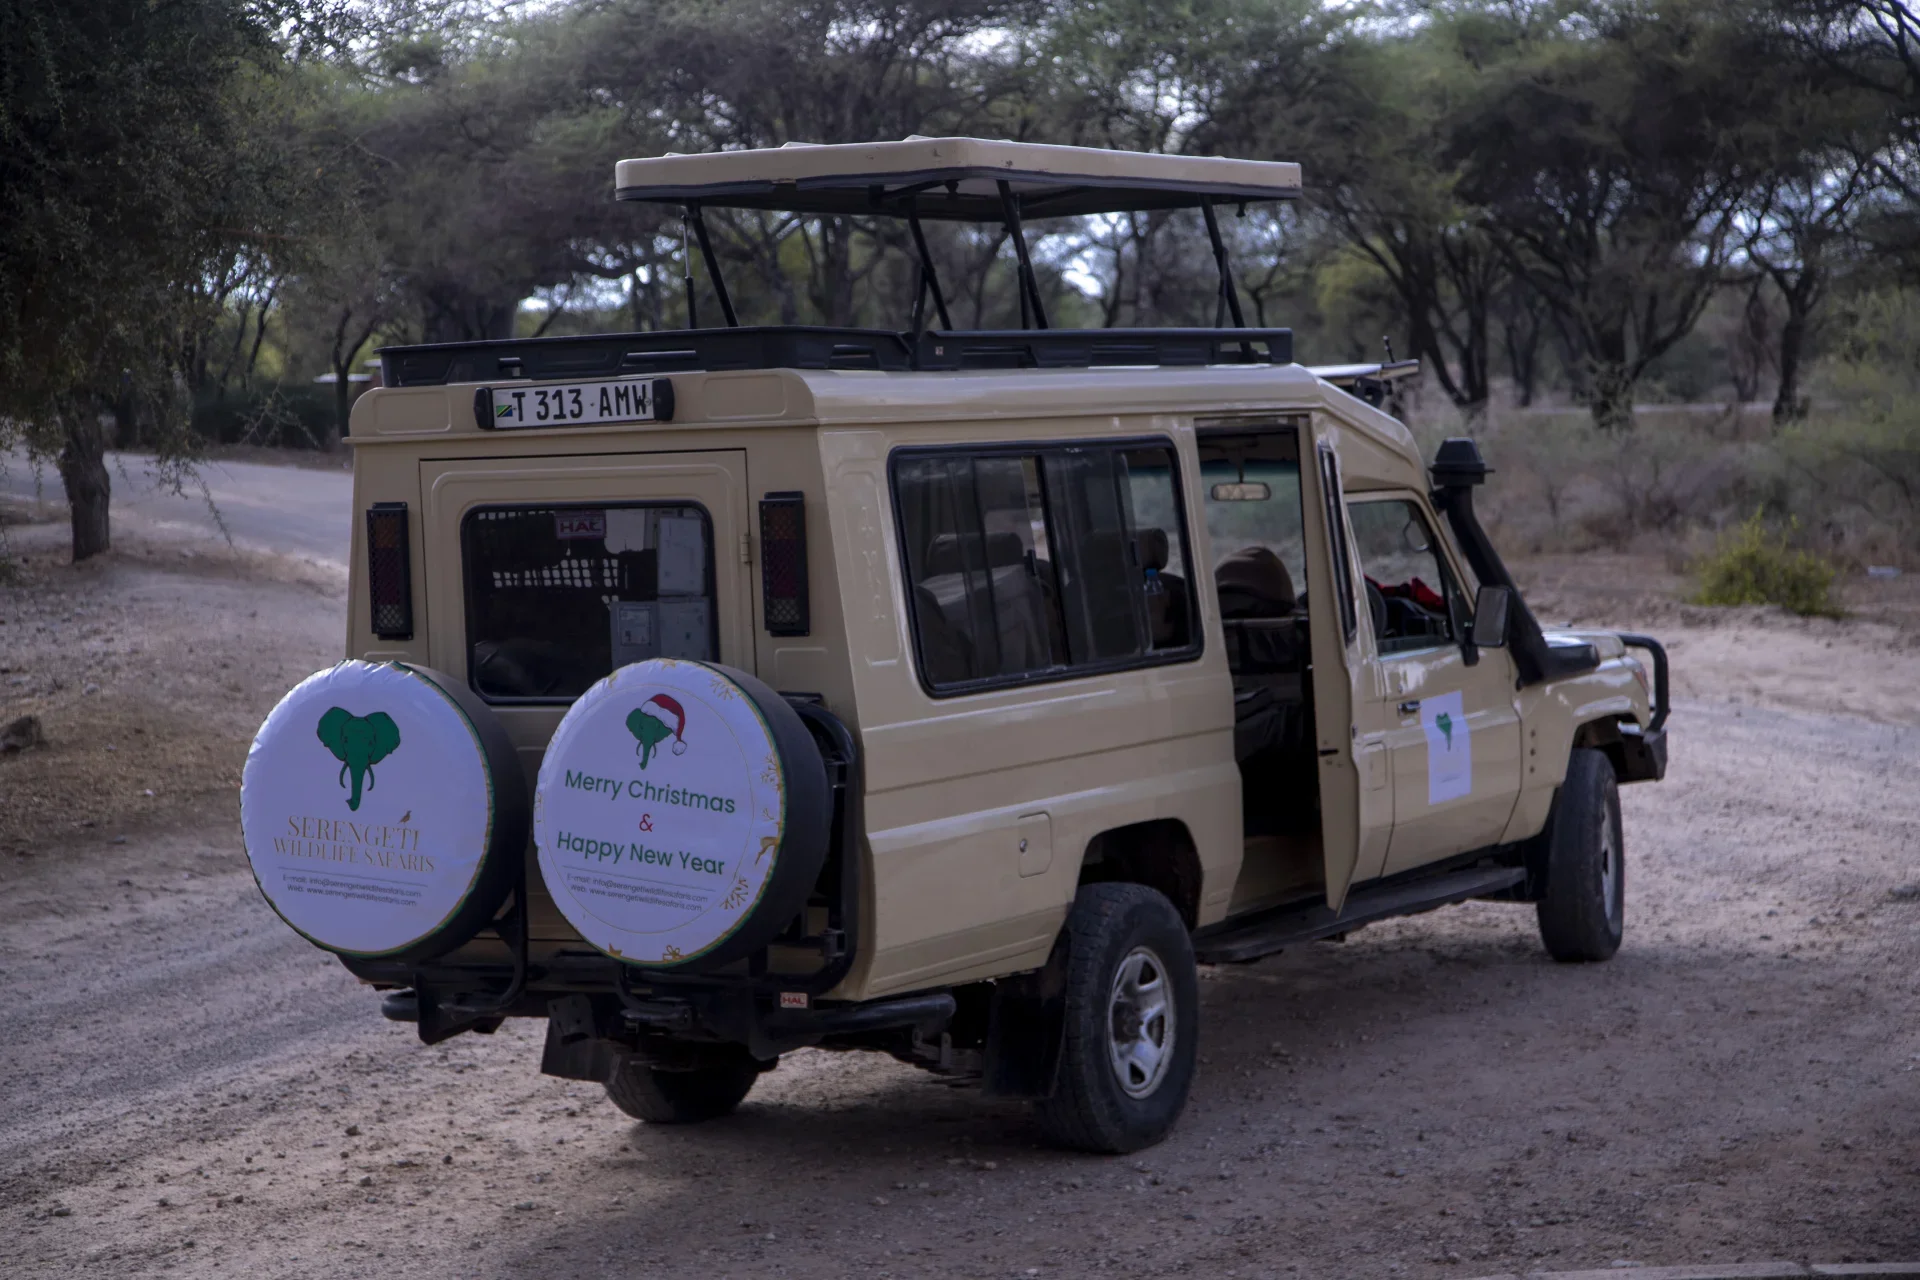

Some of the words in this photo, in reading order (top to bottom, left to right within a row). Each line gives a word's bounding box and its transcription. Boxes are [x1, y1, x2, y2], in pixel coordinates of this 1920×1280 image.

[512, 391, 526, 422] T
[535, 388, 583, 421] 313
[599, 384, 647, 417] AMW
[564, 769, 623, 801] Merry
[628, 779, 736, 814] Christmas
[287, 815, 422, 851] SERENGETI
[639, 813, 654, 833] &
[273, 837, 359, 864] WILDLIFE
[364, 849, 435, 872] SAFARIS
[557, 831, 624, 864] Happy
[630, 843, 673, 867] New
[678, 850, 725, 875] Year
[783, 996, 805, 1005] HAL
